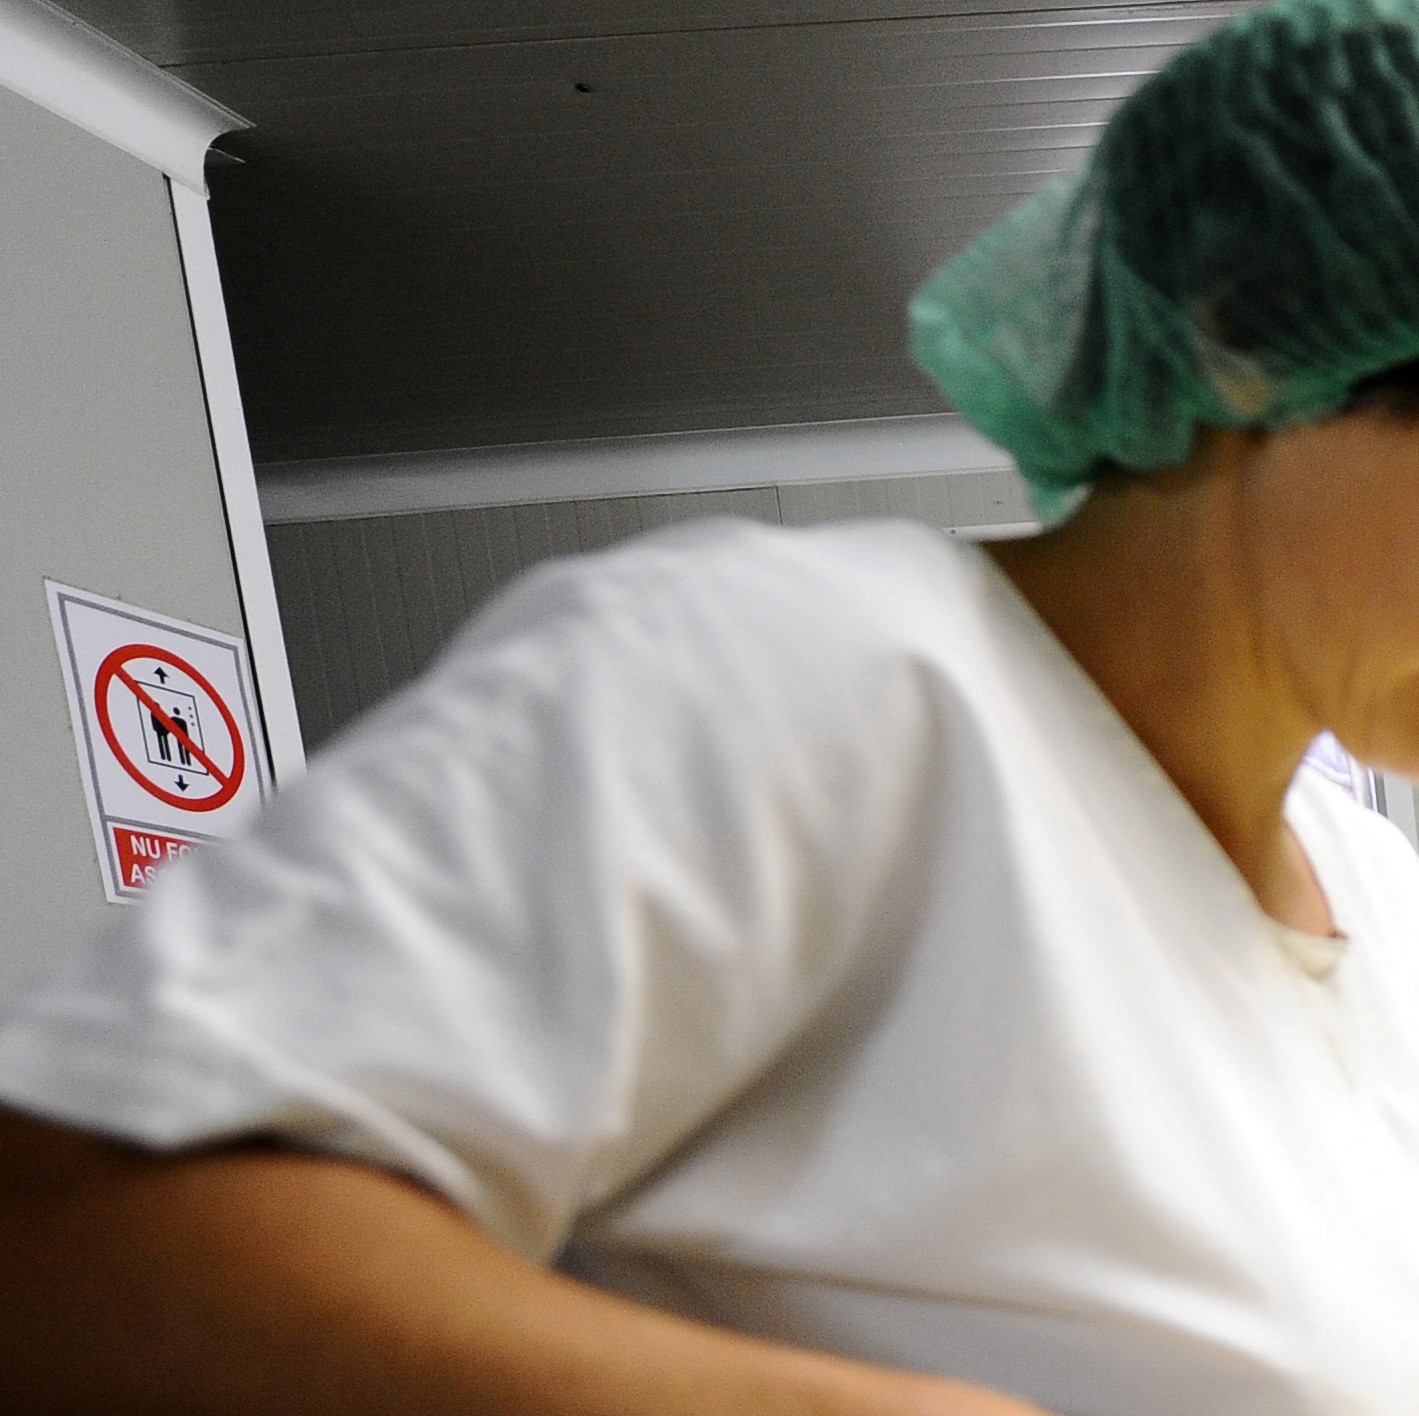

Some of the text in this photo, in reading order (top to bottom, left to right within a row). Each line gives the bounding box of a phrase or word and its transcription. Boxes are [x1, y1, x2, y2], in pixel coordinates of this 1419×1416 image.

[130, 834, 195, 862] NU FO
[130, 863, 159, 885] AS
